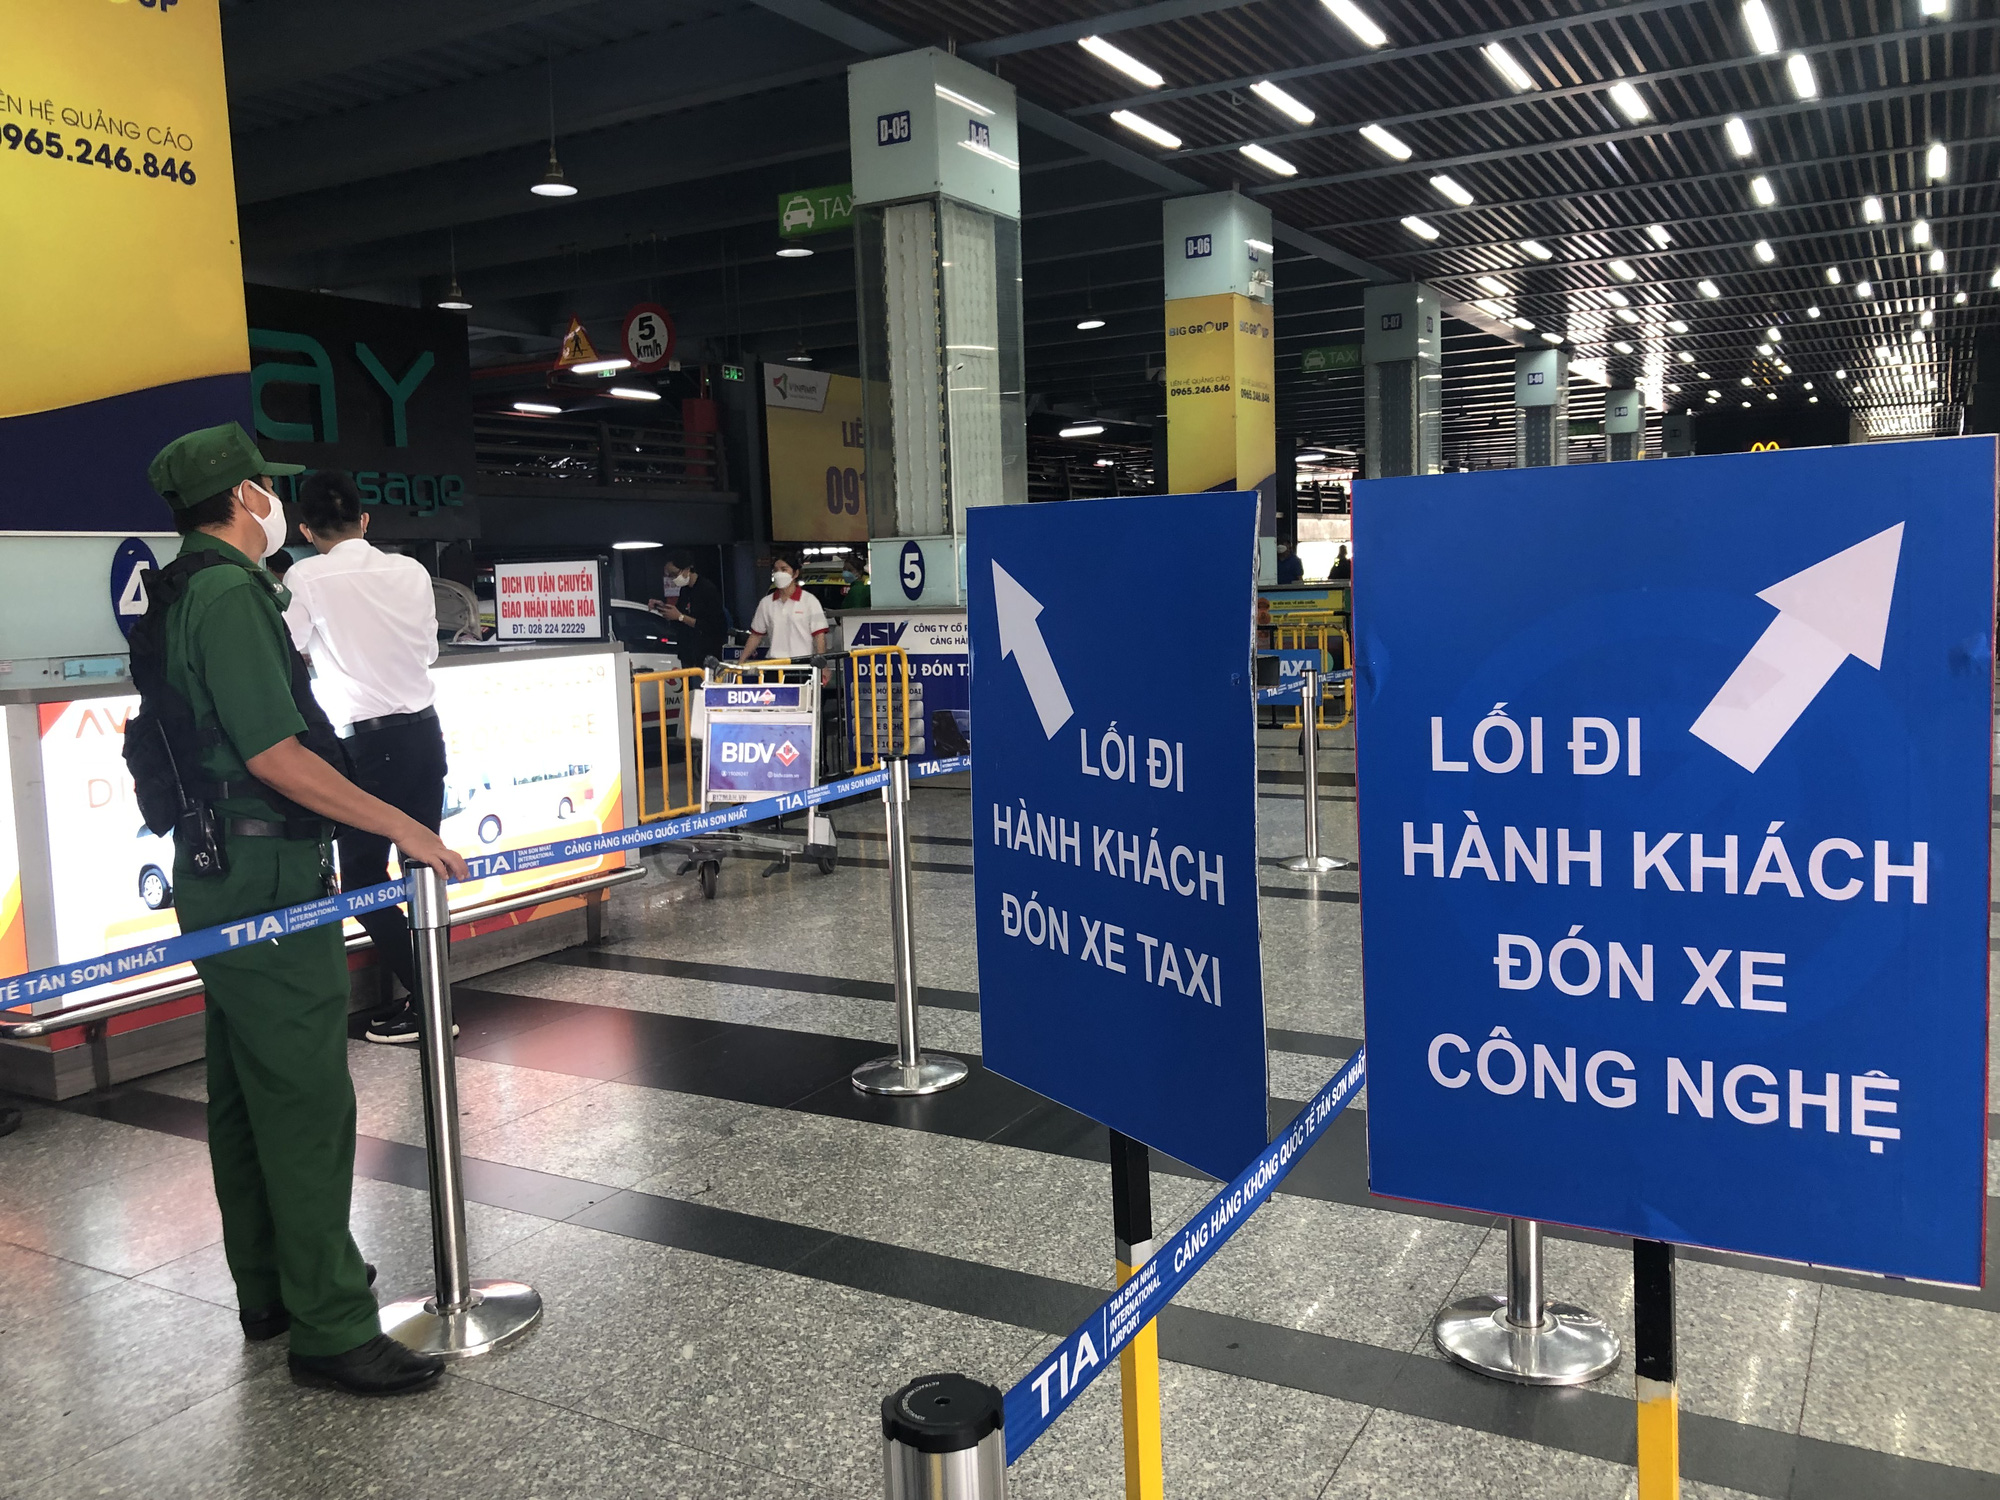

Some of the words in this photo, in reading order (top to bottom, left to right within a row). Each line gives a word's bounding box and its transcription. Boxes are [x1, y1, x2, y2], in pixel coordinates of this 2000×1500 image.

[29, 99, 55, 126] HỆ
[61, 108, 141, 140] QUẢNG
[147, 126, 193, 152] CÁO
[879, 115, 909, 142] D-05
[0, 123, 197, 186] 965.246.846
[1187, 237, 1211, 256] D-06
[638, 316, 656, 340] 5
[1168, 326, 1186, 337] BIG
[1188, 320, 1229, 335] GROUP
[1170, 384, 1231, 397] 0965.246.846
[502, 576, 522, 598] DỊCH
[524, 575, 535, 597] VỤ
[537, 571, 555, 597] VẬN
[557, 566, 593, 593] CHUYỂN
[903, 553, 922, 589] 5
[501, 601, 522, 618] GIAO
[524, 597, 548, 622] NHẬN
[550, 596, 575, 618] HÀNG
[577, 595, 596, 618] HÓA
[512, 624, 526, 635] ĐT:
[528, 624, 542, 634] 028
[544, 623, 559, 634] 224
[561, 623, 586, 634] 22229
[851, 621, 909, 647] ASV
[913, 623, 937, 633] CÔNG
[939, 624, 948, 632] TY
[858, 663, 894, 677] DCH
[921, 659, 953, 677] ĐÓN
[727, 690, 761, 704] BIDV
[721, 741, 776, 764] BIDV
[1431, 702, 1543, 774] LỐI
[1567, 716, 1641, 776] ĐI
[917, 760, 940, 776] TIA
[1080, 720, 1136, 783] LỐI
[1146, 737, 1184, 793] ĐI
[775, 793, 804, 812] TIA
[836, 783, 850, 793] TAN
[850, 780, 864, 789] SON
[864, 776, 881, 787] NHAT
[467, 855, 511, 878] TIA
[564, 840, 591, 856] CẢNG
[593, 836, 620, 850] HÀNG
[622, 829, 653, 845] KHÔNG
[654, 822, 679, 839] QUỐC
[680, 819, 691, 832] TẾ
[693, 816, 709, 831] TÂN
[710, 813, 727, 827] SƠN
[727, 806, 748, 823] NHẤT
[518, 851, 555, 863] INTERNATIONAL
[993, 797, 1081, 867] HÀNH
[1092, 827, 1225, 906] KHÁCH
[1403, 809, 1602, 888] HÀNH
[1633, 820, 1929, 905] KHÁCH
[518, 860, 540, 870] AIRPORT
[221, 915, 284, 947] TIA
[347, 892, 374, 911] TAN
[378, 884, 405, 903] SON
[289, 905, 302, 914] TAN
[302, 902, 317, 912] SON
[318, 898, 335, 908] NHAT
[289, 905, 340, 923] INTERNATIONAL
[290, 918, 319, 931] AIRPORT
[1001, 891, 1070, 956] ĐÓN
[1080, 915, 1127, 975] XE
[1136, 932, 1222, 1007] TAXI
[0, 978, 20, 1001] TẾ
[25, 974, 66, 995] TÂN
[71, 962, 113, 985] SƠN
[118, 945, 167, 973] NHẤT
[1493, 924, 1654, 1002] ĐÓN
[1680, 946, 1787, 1013] XE
[1427, 1025, 1637, 1109] CÔNG
[1667, 1056, 1900, 1154] NGHỆ
[1031, 1330, 1100, 1419] TIA
[1174, 1222, 1208, 1273] CẢNG
[1210, 1189, 1242, 1239] HÀNG
[1243, 1153, 1279, 1205] KHÔNG
[1280, 1120, 1304, 1166] QUỐC
[1305, 1101, 1316, 1138] TẾ
[1316, 1093, 1331, 1125] TÂN
[1109, 1294, 1124, 1315] TAN
[1124, 1278, 1139, 1302] SON
[1139, 1259, 1158, 1288] NHAT
[1109, 1274, 1162, 1335] INTERNATIONAL
[1110, 1311, 1141, 1352] AIRPORT
